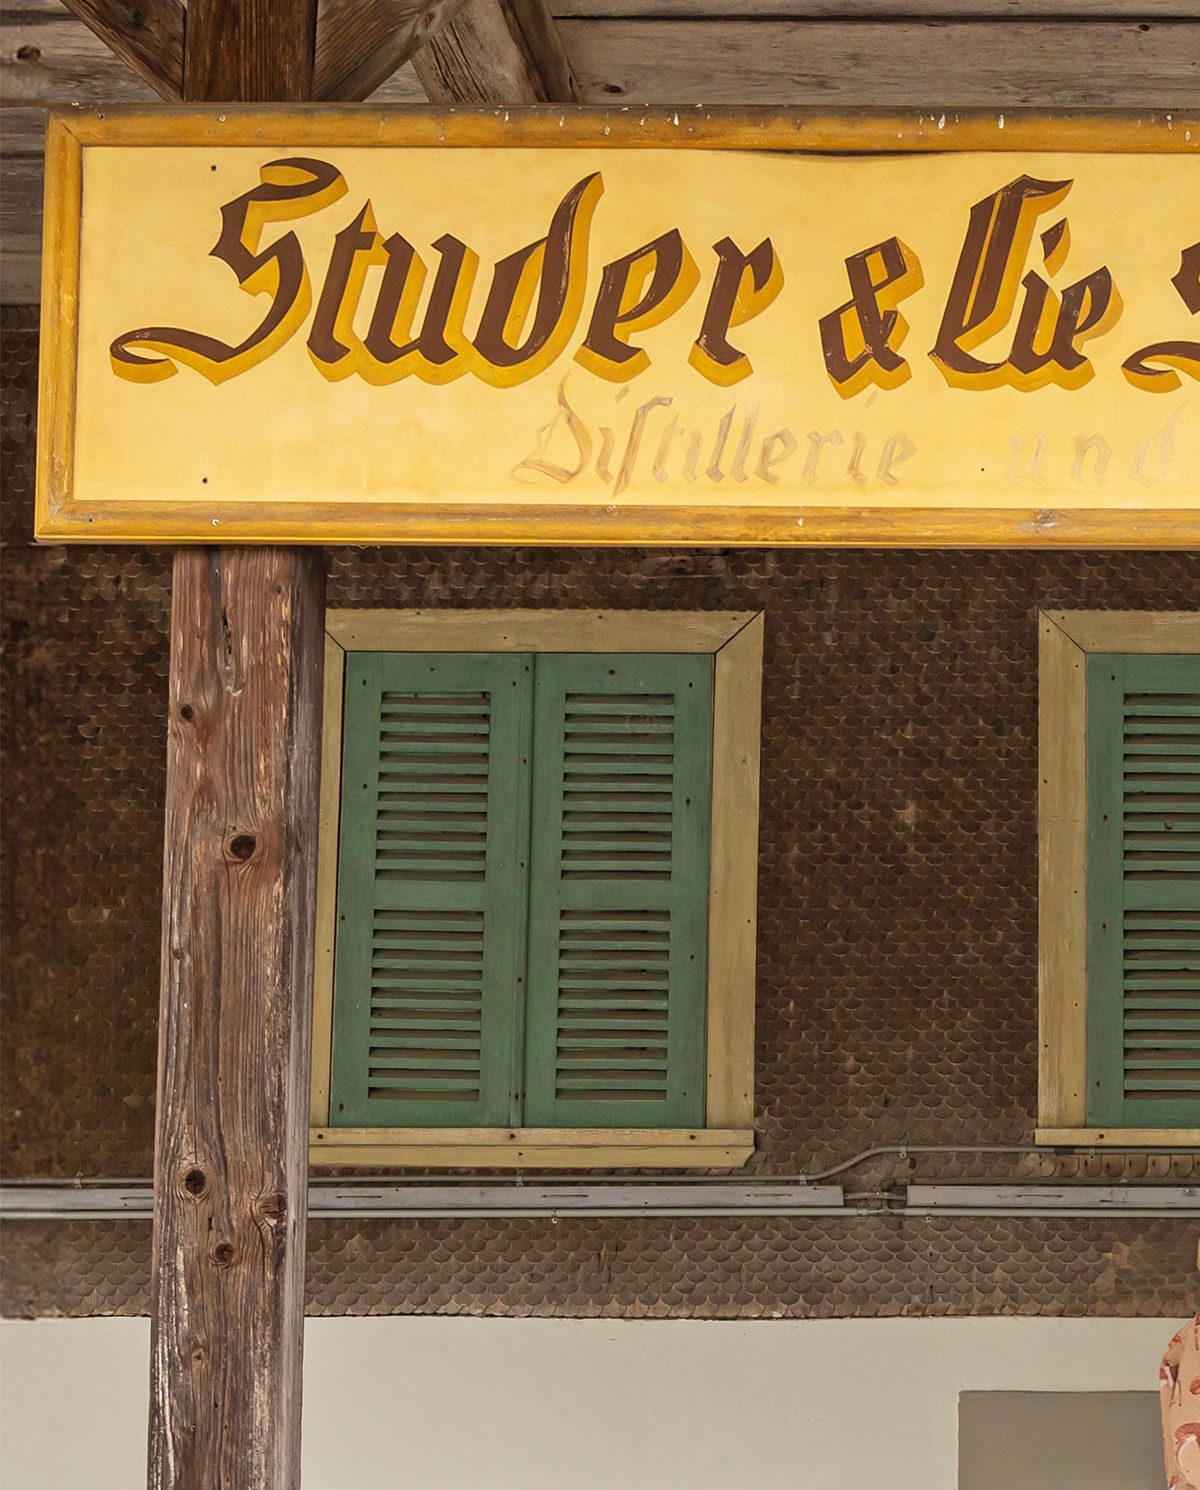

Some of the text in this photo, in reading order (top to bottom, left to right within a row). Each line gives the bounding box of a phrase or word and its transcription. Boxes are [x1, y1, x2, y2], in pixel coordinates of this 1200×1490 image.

[110, 156, 783, 387] Studer
[819, 236, 924, 399] &
[927, 173, 1124, 390] Cie
[1003, 400, 1191, 487] und
